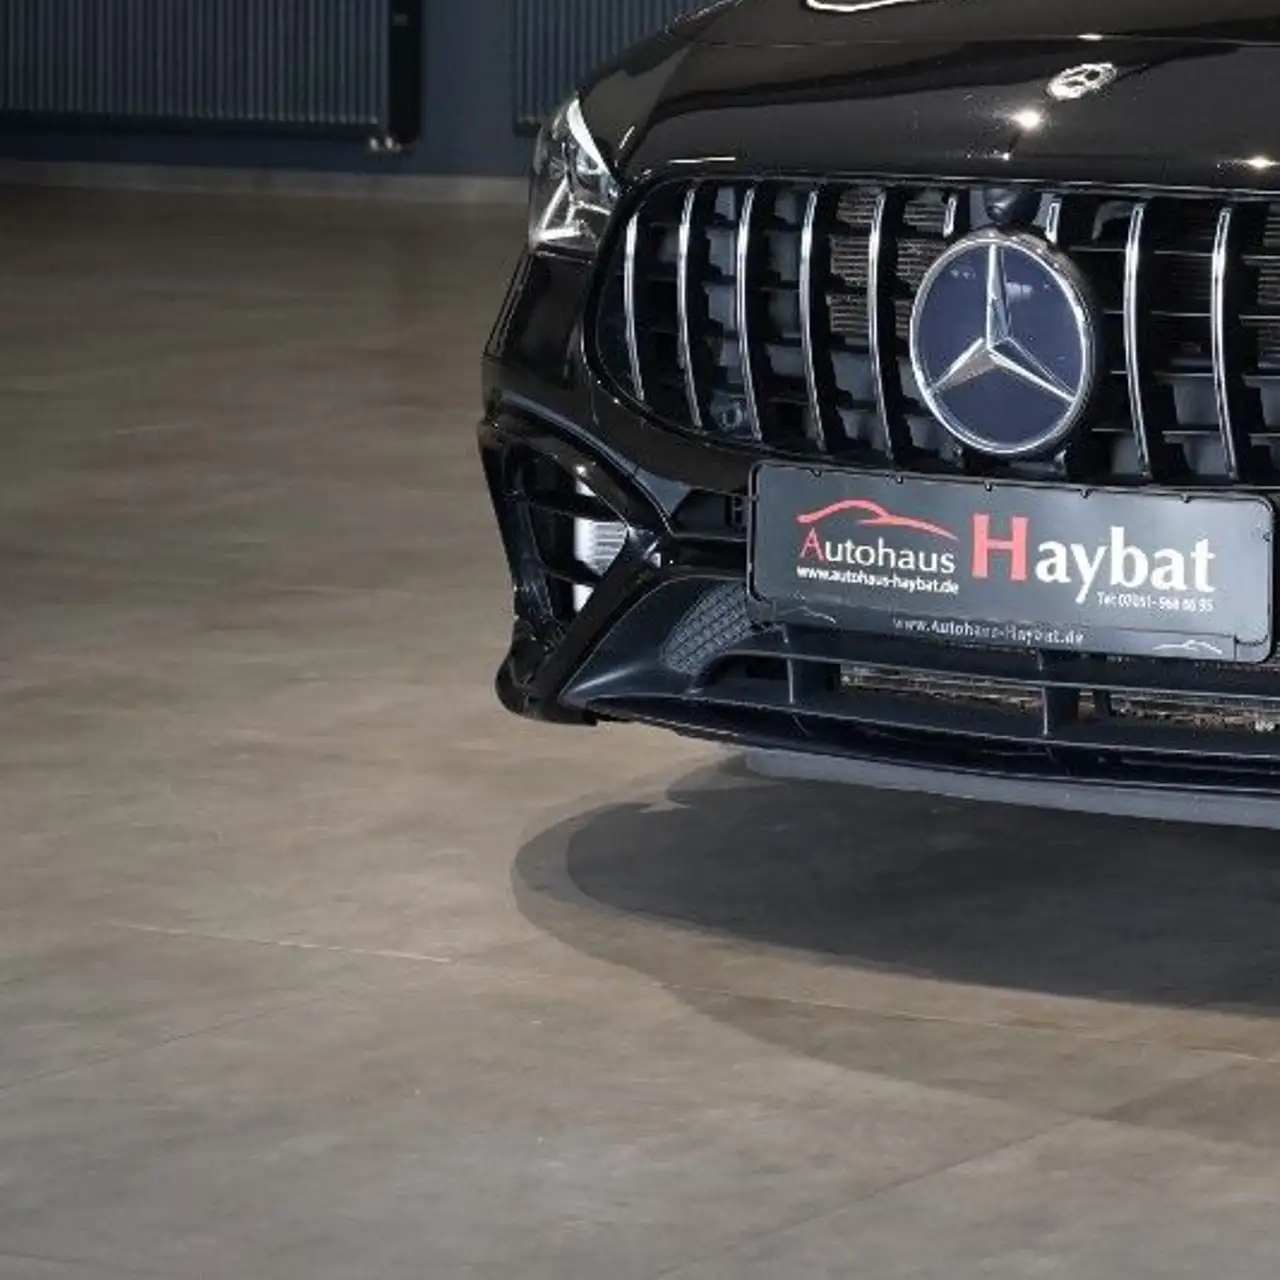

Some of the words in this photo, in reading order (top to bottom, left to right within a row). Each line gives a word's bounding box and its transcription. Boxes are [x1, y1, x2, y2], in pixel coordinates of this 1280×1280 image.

[796, 564, 959, 596] www.autohaus-haybat.de
[799, 526, 956, 574] Autohaus
[970, 512, 1216, 602] Haybat
